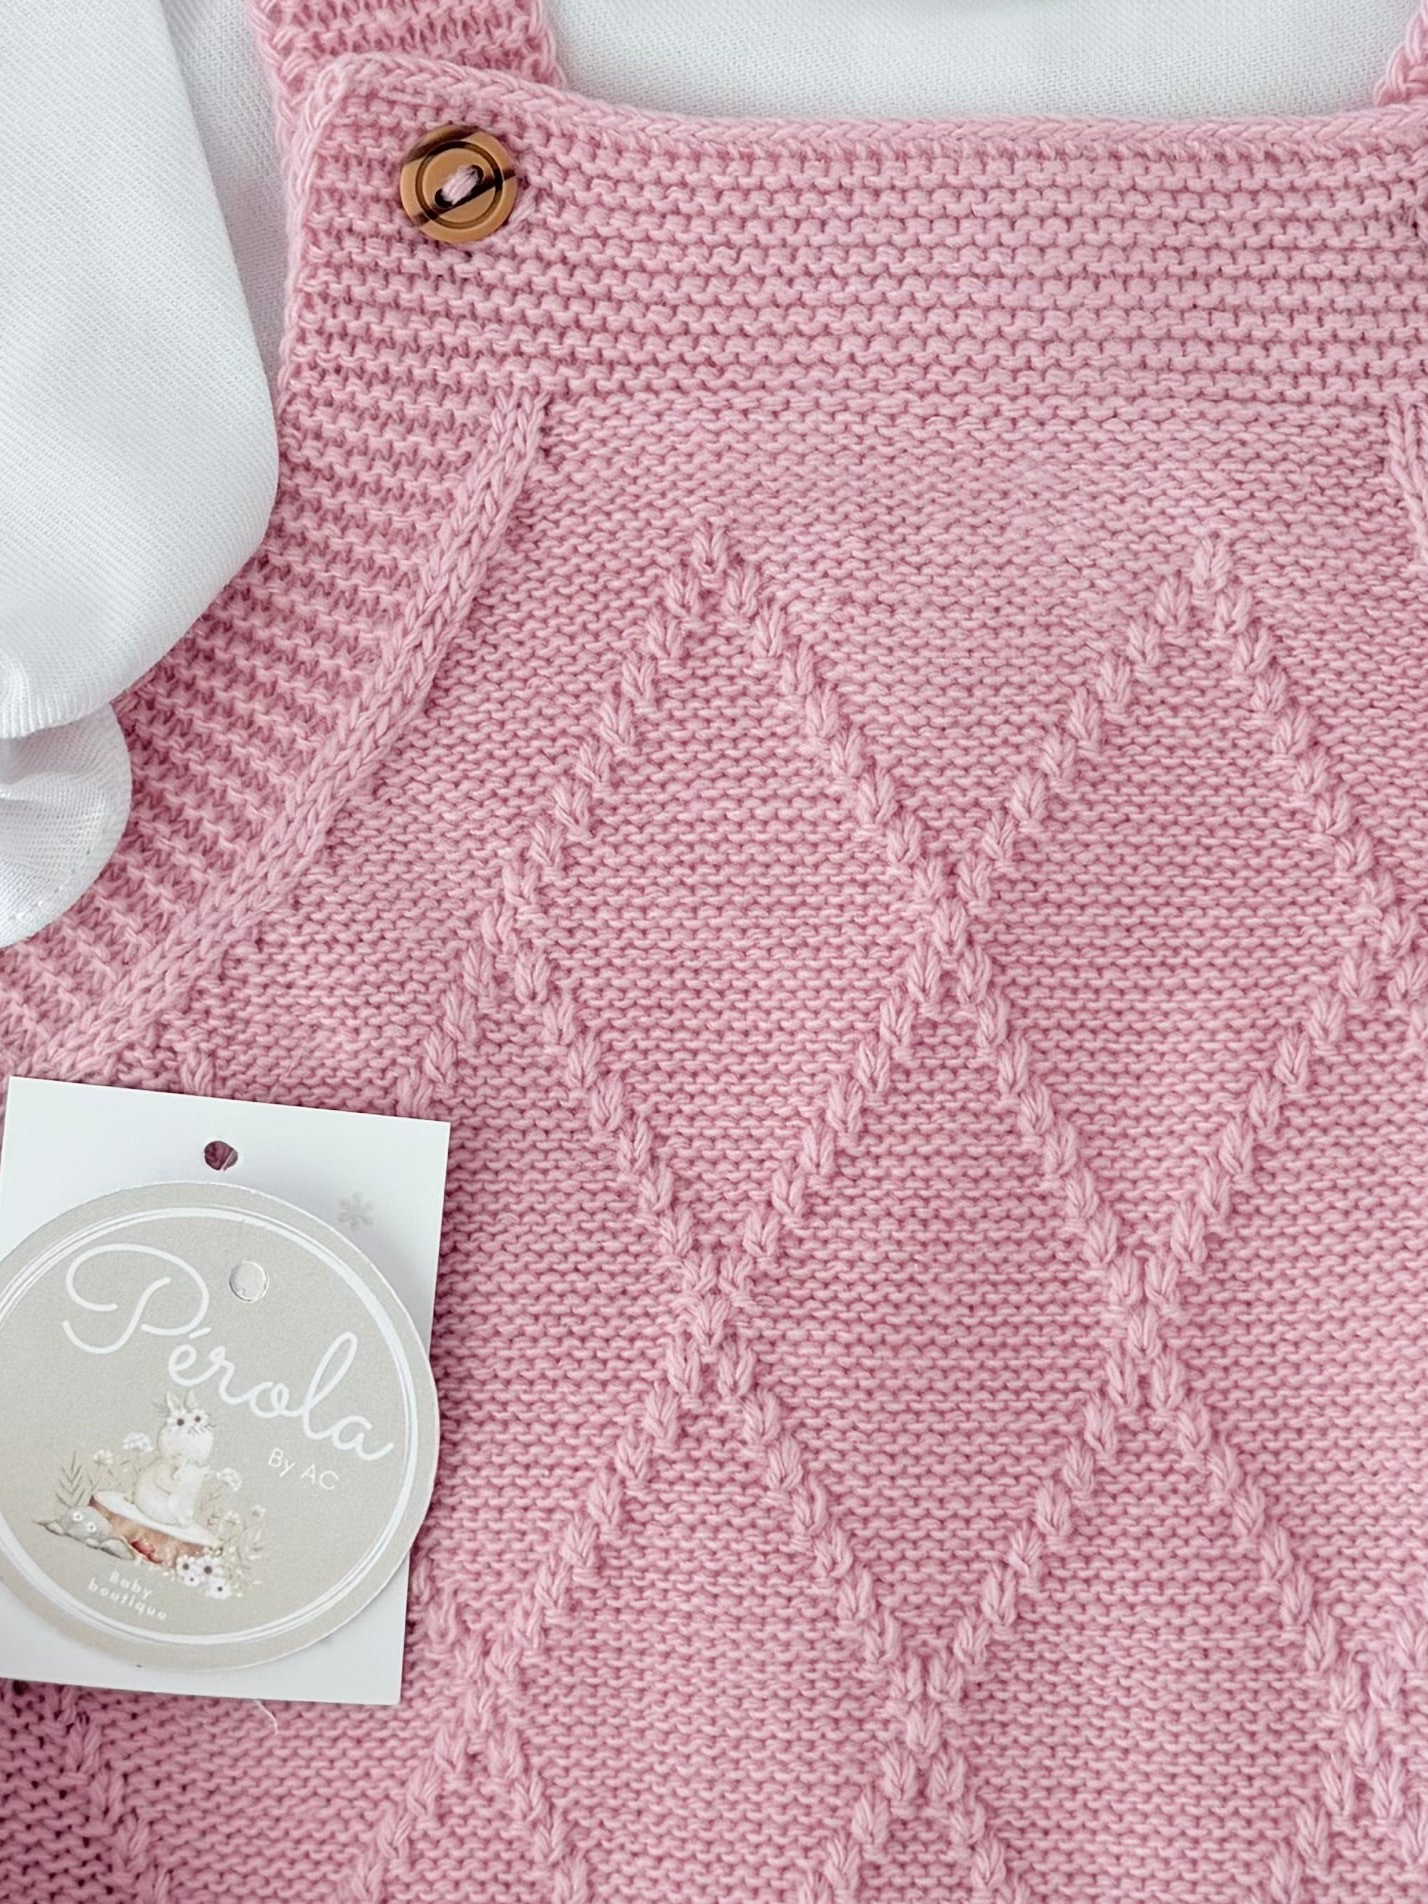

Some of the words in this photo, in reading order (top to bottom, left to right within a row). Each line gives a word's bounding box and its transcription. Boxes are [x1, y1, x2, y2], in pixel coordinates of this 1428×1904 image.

[64, 1244, 394, 1461] Pérola
[269, 1448, 295, 1478] By
[302, 1464, 339, 1490] AC
[109, 1570, 153, 1600] Baby
